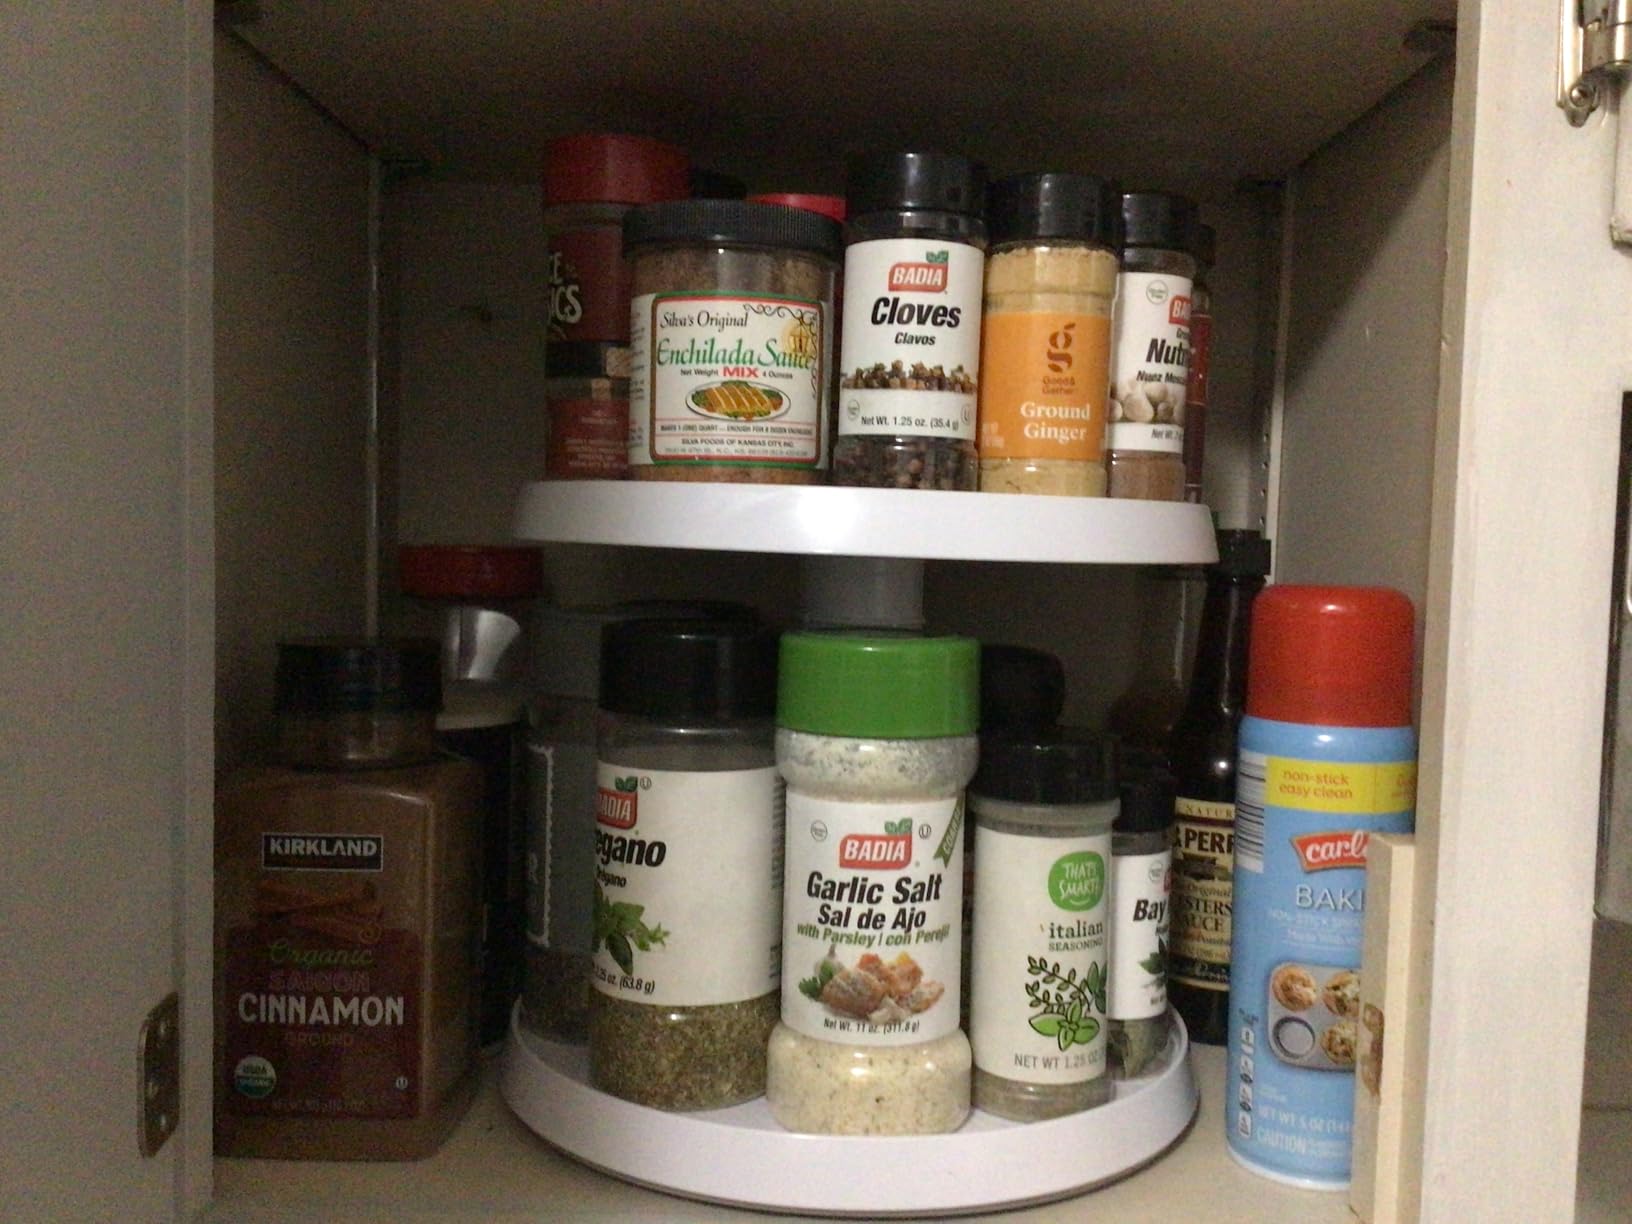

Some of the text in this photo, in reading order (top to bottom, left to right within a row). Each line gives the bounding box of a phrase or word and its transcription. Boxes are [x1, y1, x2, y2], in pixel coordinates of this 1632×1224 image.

[892, 266, 943, 286] BADIA
[660, 309, 749, 332] Silva's Original
[871, 297, 962, 328] Cloves
[894, 332, 936, 346] Clavos
[656, 336, 812, 370] Enchilada Sauce
[680, 367, 693, 377] Net
[694, 367, 719, 378] Weight
[768, 371, 793, 380] Ounces
[722, 366, 759, 379] MIX
[1020, 402, 1091, 421] Ground
[861, 416, 876, 426] Net
[876, 416, 890, 427] Wt.
[893, 416, 913, 427] 1.25
[915, 418, 928, 428] oz.
[930, 418, 951, 430] (35.4
[1024, 422, 1088, 444] Ginger
[727, 438, 737, 446] OF
[738, 439, 766, 447] KANSAS
[1283, 769, 1350, 786] non-stick
[1279, 783, 1353, 799] easy clean
[598, 794, 632, 821] ADIA
[1185, 804, 1234, 818] NATUR
[270, 838, 378, 857] KIRKLAND
[595, 829, 667, 868] egano
[844, 839, 906, 862] BADIA
[1306, 830, 1368, 862] carl
[807, 870, 943, 905] Garlic Salt
[1296, 883, 1366, 911] BAKI
[817, 903, 927, 934] Sal de Ajo
[1133, 898, 1167, 923] Bay
[797, 922, 820, 940] with
[822, 927, 876, 949] Parsley
[886, 932, 912, 947] con
[915, 924, 951, 945] Perejil
[1050, 920, 1104, 939] italian
[270, 940, 374, 968] Organic
[1048, 937, 1104, 952] SEASONING
[619, 974, 643, 992] (63.8
[644, 979, 656, 995] g)
[238, 992, 405, 1026] CINNAMON
[824, 1018, 837, 1031] Net
[839, 1019, 852, 1032] Wt.
[1013, 1054, 1037, 1067] NET
[1042, 1055, 1061, 1069] WT
[1064, 1053, 1087, 1070] 1.25
[1256, 1126, 1307, 1155] CAUTION
